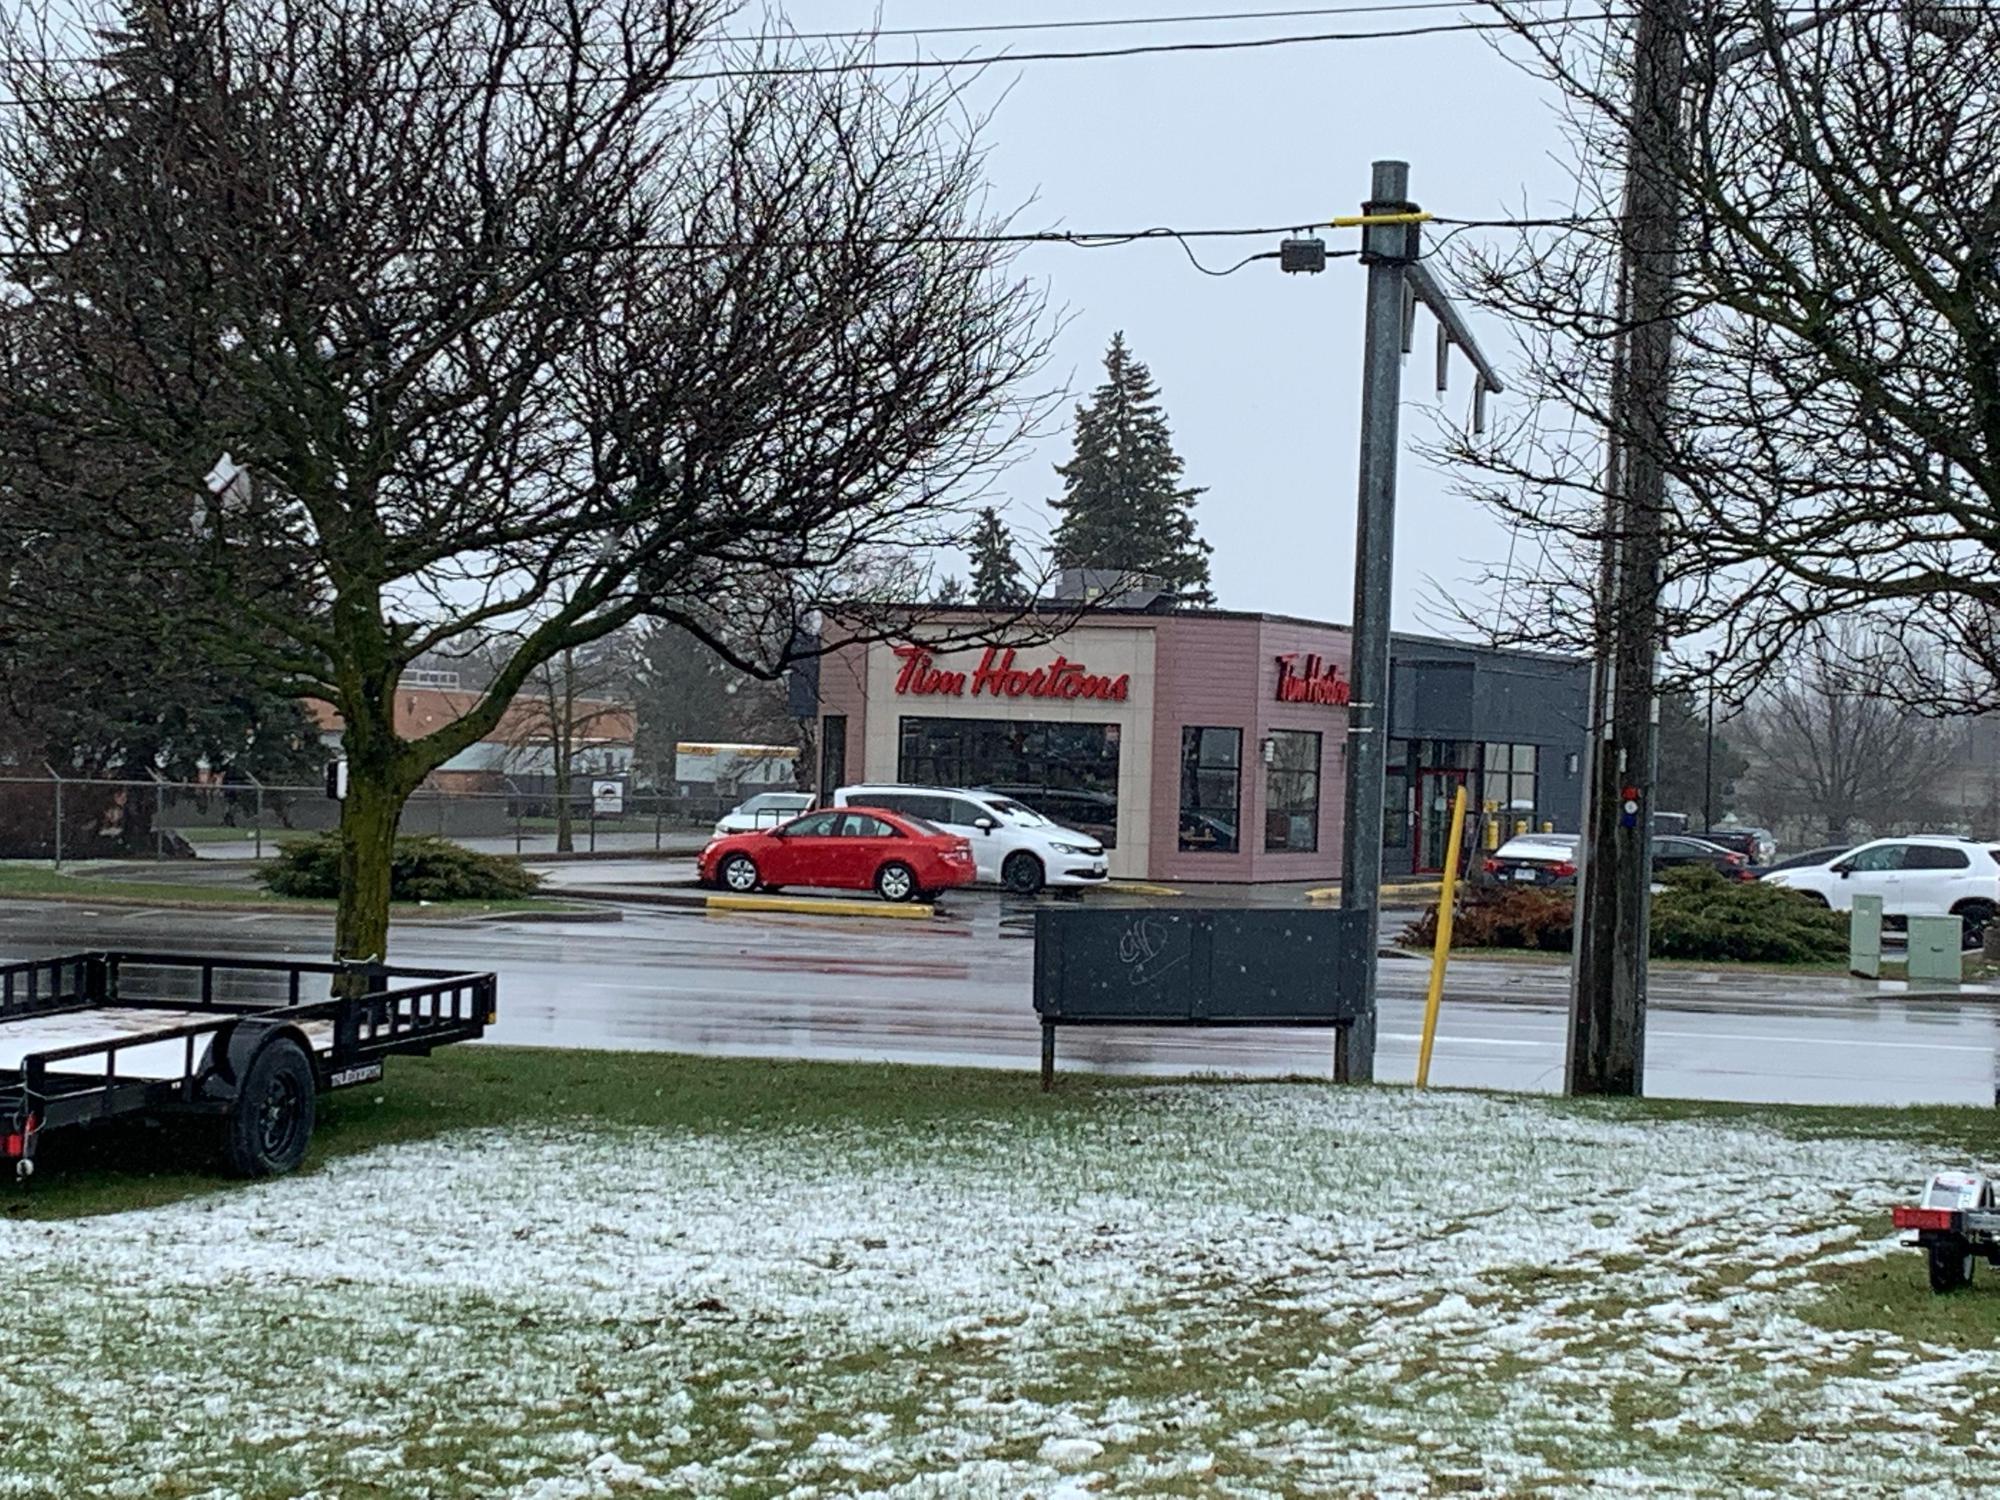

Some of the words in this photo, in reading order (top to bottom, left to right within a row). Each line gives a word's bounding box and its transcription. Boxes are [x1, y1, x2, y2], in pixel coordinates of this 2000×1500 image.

[893, 645, 967, 697] Tim
[970, 646, 1130, 701] Hortons
[1275, 652, 1304, 702] Tim
[1303, 653, 1350, 705] Horton
